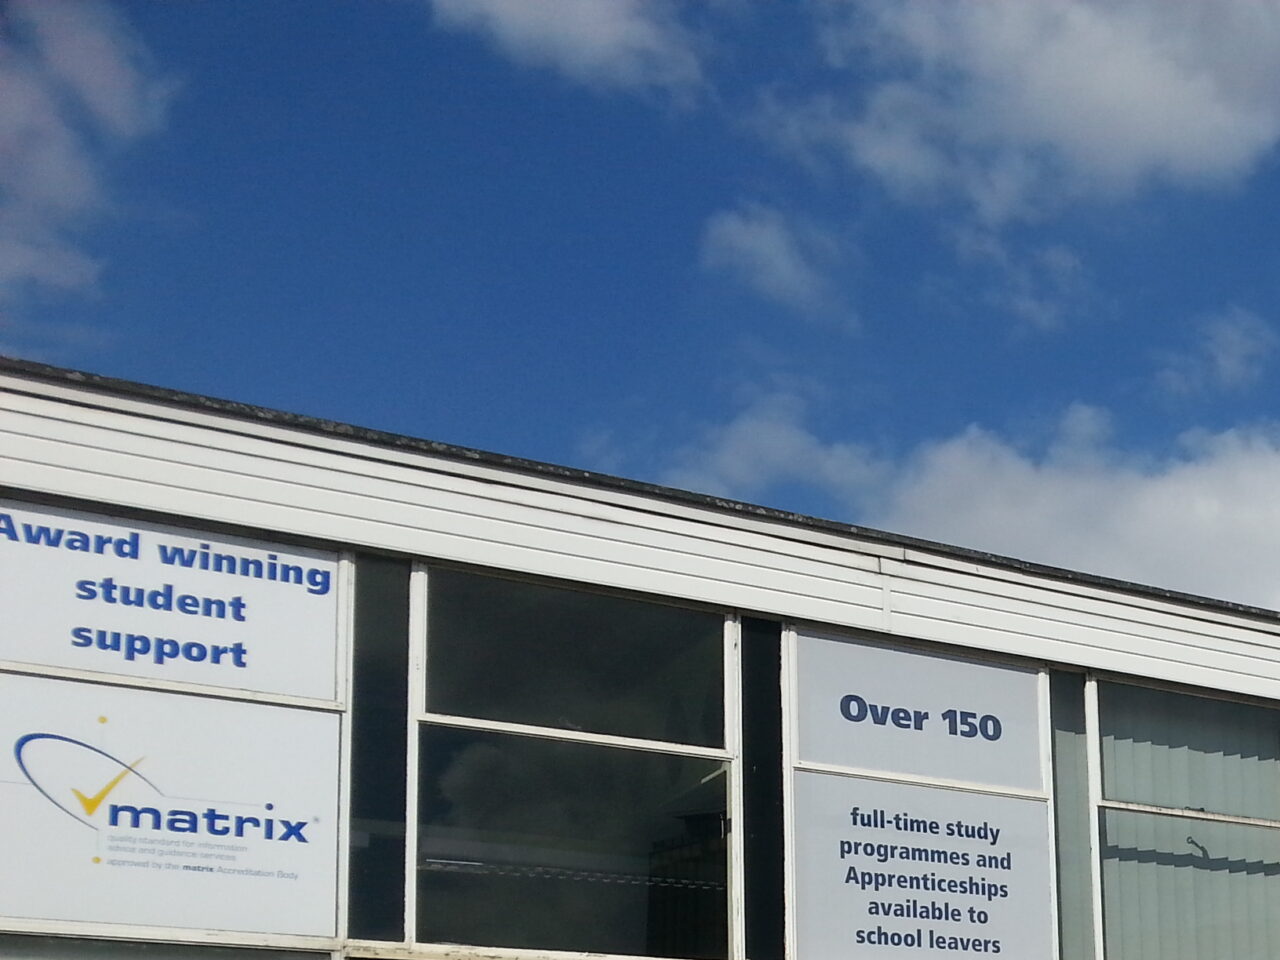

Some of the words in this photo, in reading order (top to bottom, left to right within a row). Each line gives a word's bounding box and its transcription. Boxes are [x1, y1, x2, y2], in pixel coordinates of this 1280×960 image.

[0, 513, 140, 561] Award
[158, 543, 331, 595] winning
[75, 577, 247, 622] student
[71, 625, 248, 668] support
[840, 694, 929, 731] Over
[941, 709, 1002, 741] 150
[108, 802, 309, 843] matrix
[850, 807, 940, 835] full-time
[946, 820, 1000, 846] study
[164, 862, 179, 870] the
[182, 864, 214, 873] matrix
[277, 870, 299, 881] Body
[840, 839, 970, 867] programmes
[976, 852, 1011, 870] and
[844, 866, 1008, 901] Apprenticeships
[868, 899, 961, 922] available
[968, 906, 988, 924] to
[855, 926, 922, 948] school
[929, 930, 1001, 953] leavers
